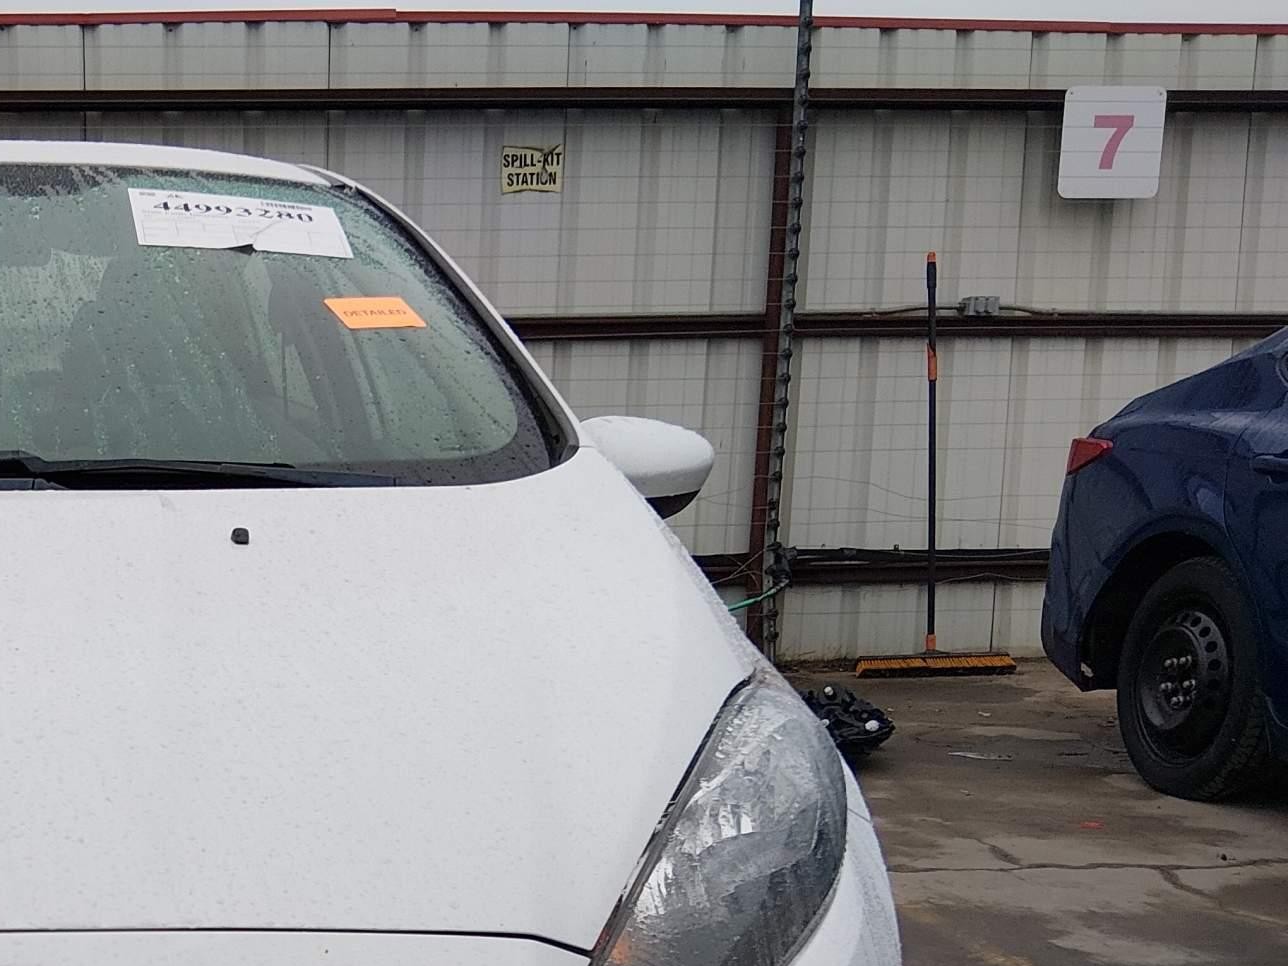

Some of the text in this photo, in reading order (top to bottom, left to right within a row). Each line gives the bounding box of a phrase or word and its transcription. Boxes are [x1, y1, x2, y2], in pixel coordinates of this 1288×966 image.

[1093, 114, 1135, 170] 7
[503, 151, 562, 169] SPILL-KIT
[506, 171, 557, 187] STATION
[153, 201, 314, 222] 44993280
[343, 308, 408, 318] DETAILED
